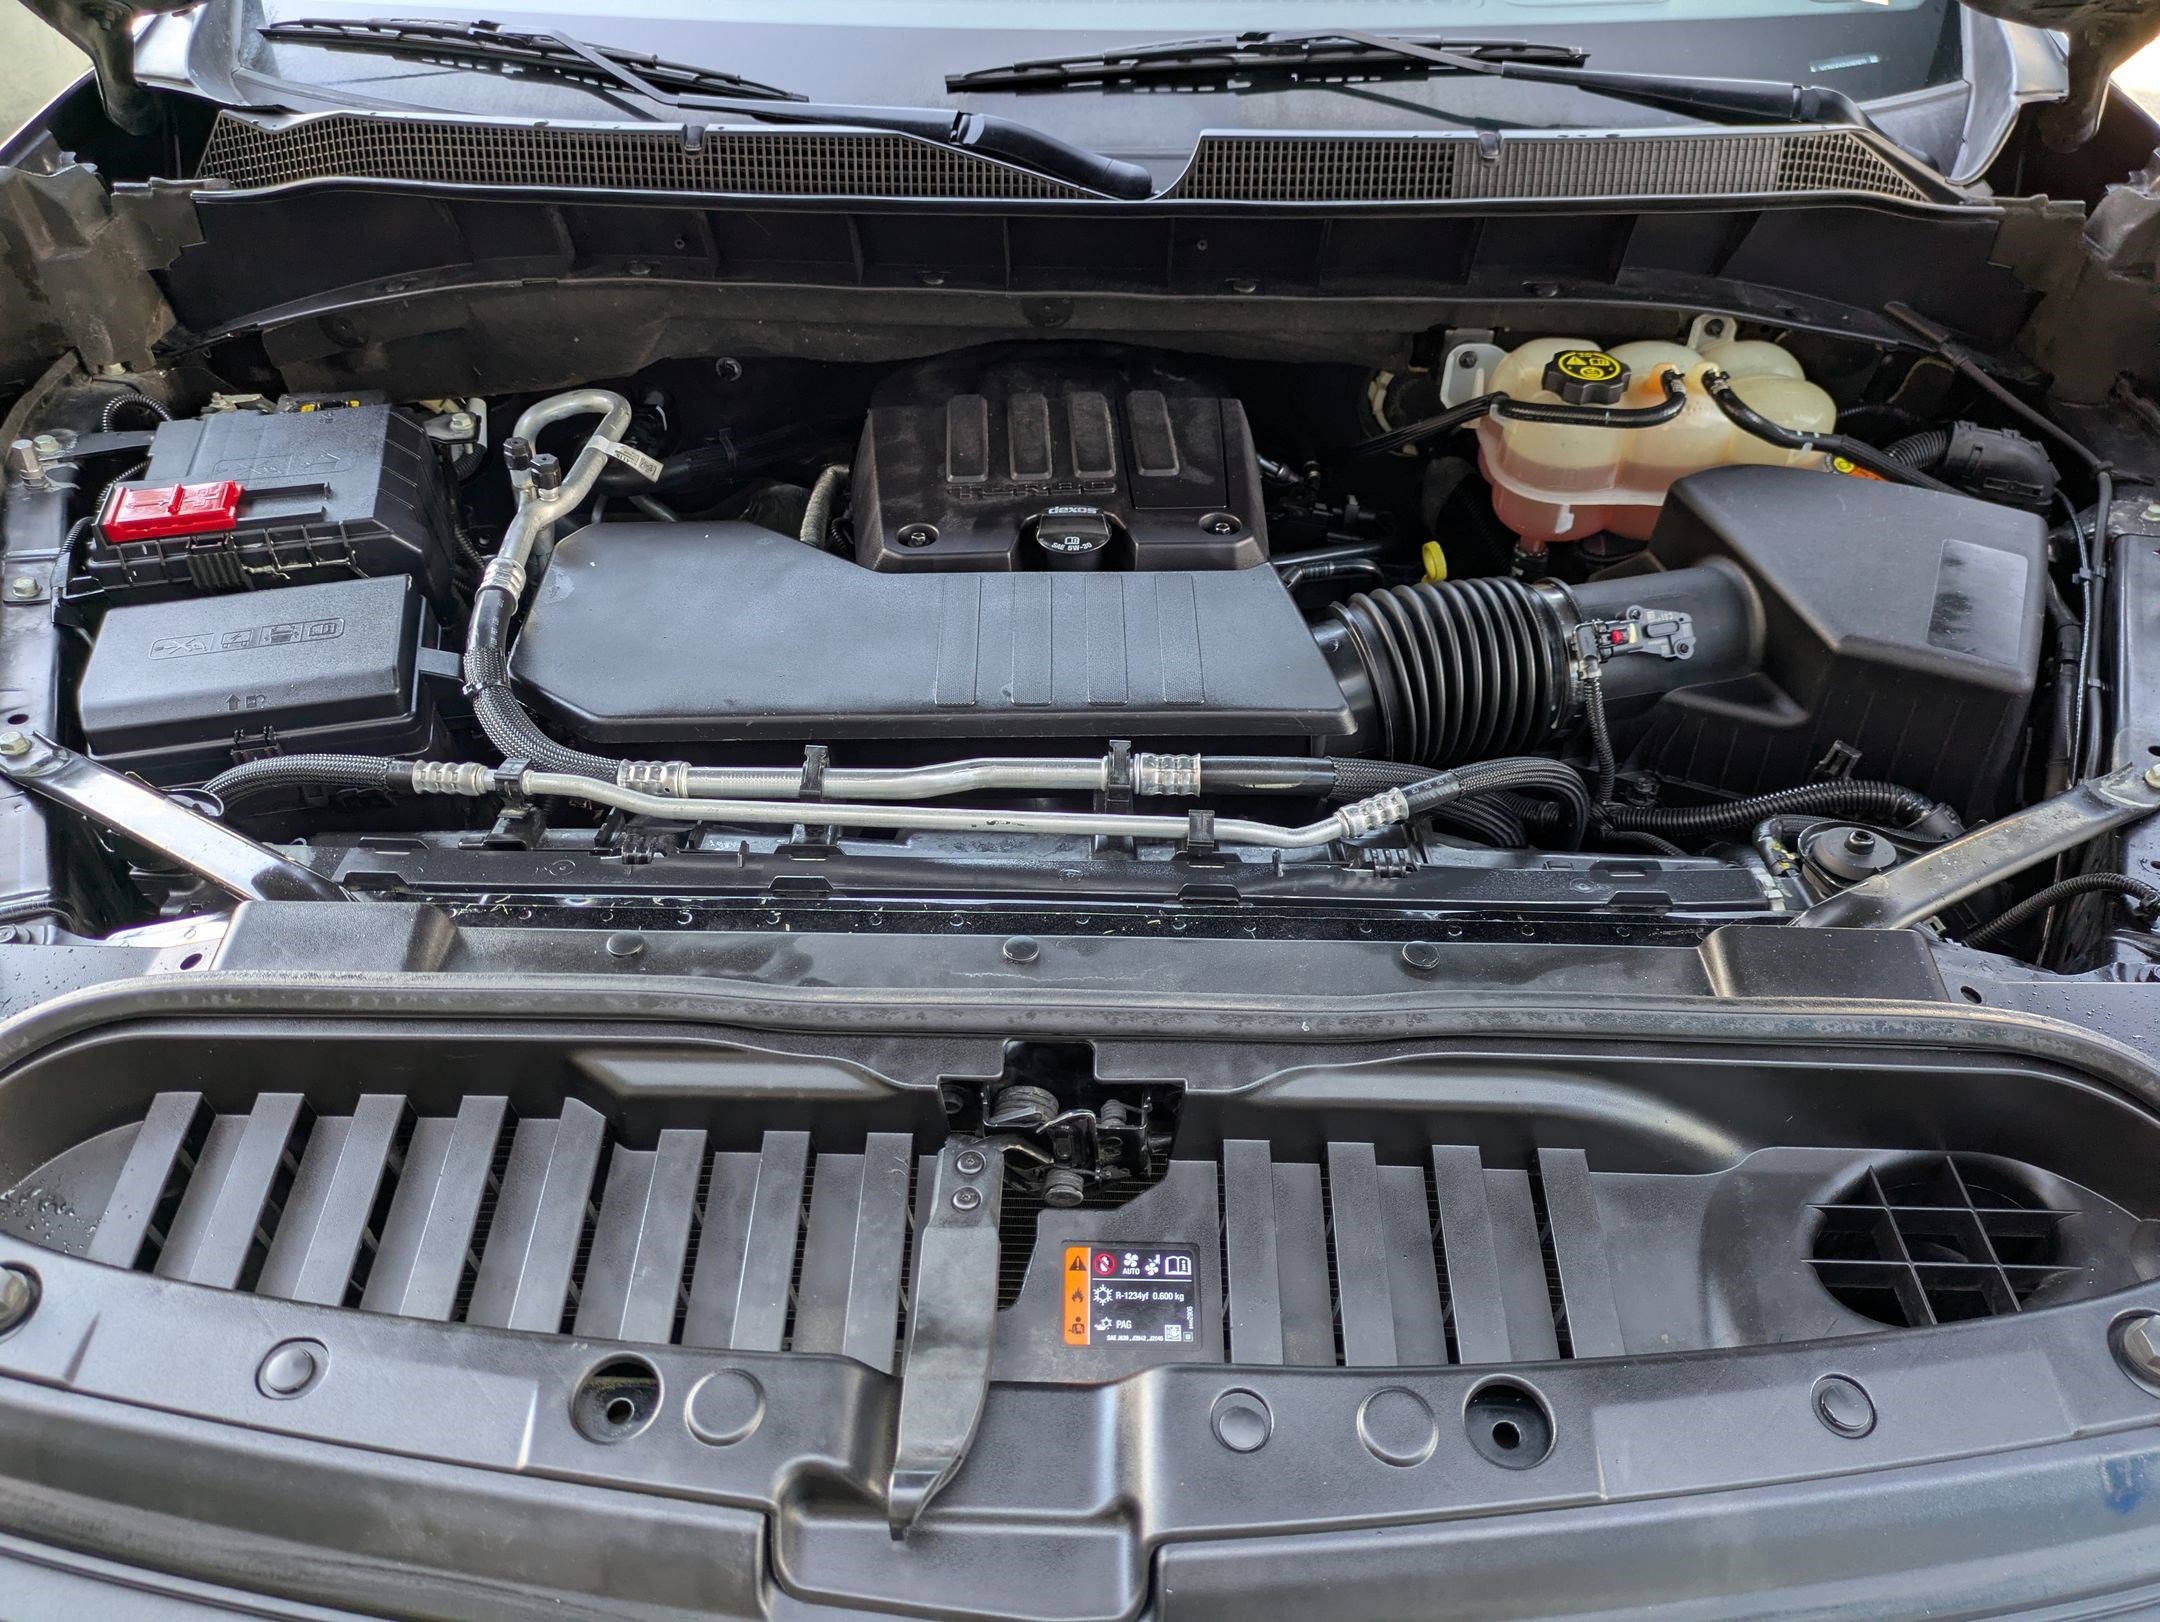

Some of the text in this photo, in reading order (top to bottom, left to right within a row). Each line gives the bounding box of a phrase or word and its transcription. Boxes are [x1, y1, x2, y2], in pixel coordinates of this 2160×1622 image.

[1048, 505, 1098, 514] dexos
[1067, 541, 1093, 551] 5W-30
[1122, 1267, 1140, 1275] AUTO
[1116, 1291, 1184, 1302] R-1234yf 0.600 kg
[1116, 1320, 1132, 1329] PAG
